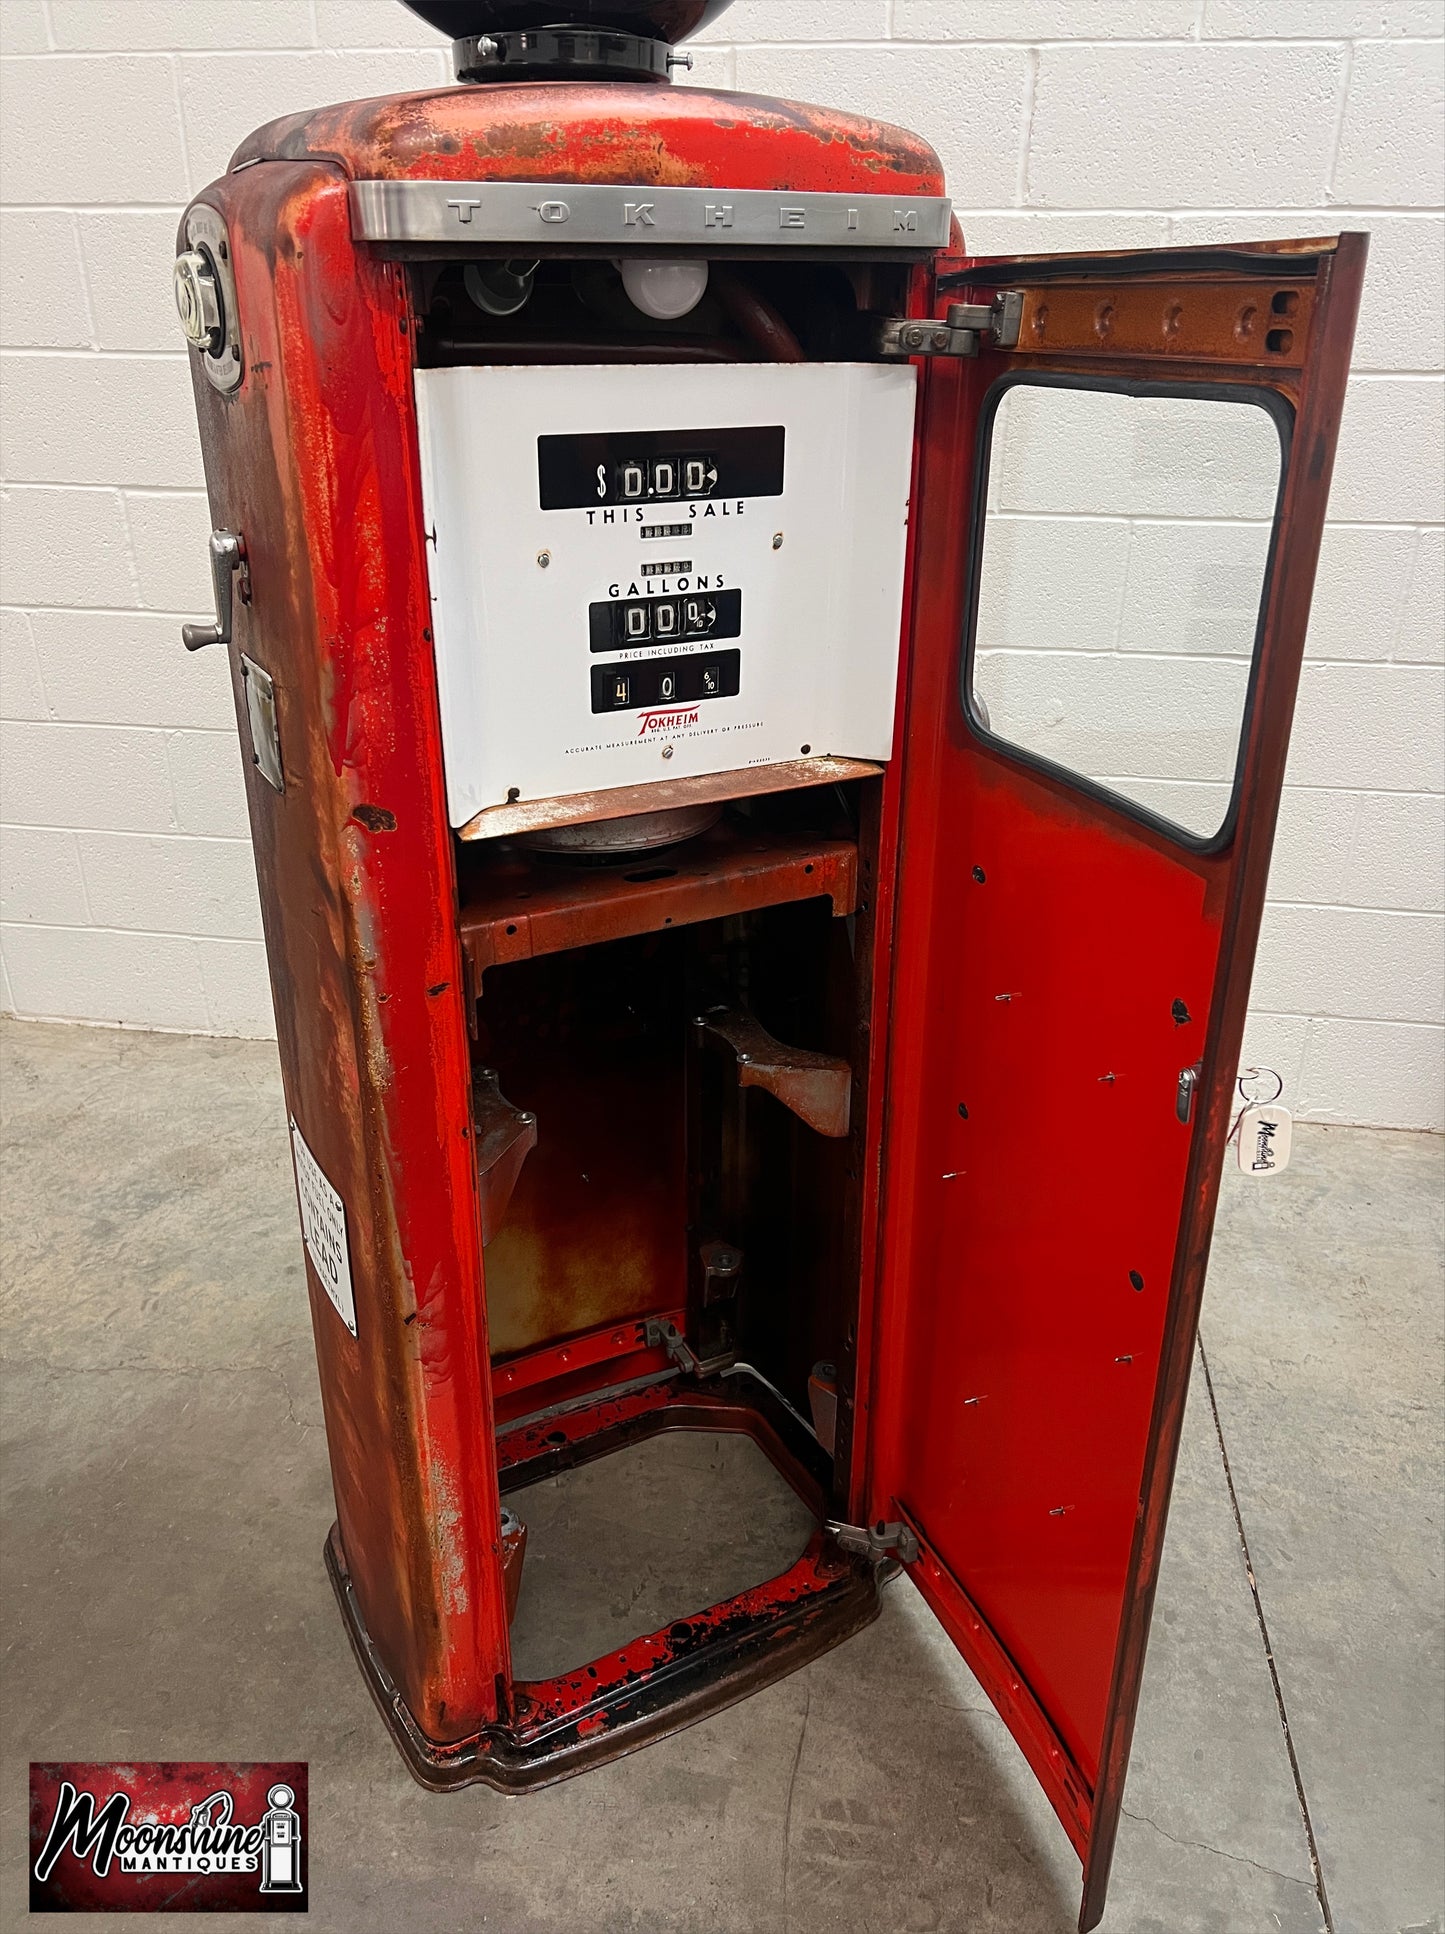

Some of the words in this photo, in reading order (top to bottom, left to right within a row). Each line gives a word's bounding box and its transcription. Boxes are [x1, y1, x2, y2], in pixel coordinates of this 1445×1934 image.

[447, 198, 917, 232] TOKHEIM
[596, 464, 607, 499] $
[586, 508, 645, 525] THIS
[688, 501, 745, 518] SALE
[608, 574, 725, 598] GALLONS
[619, 651, 643, 660] PRICE
[647, 644, 695, 657] INCLUDING
[699, 643, 715, 651] TAX
[616, 682, 627, 702] 4
[636, 704, 701, 737] TOKHEIM
[564, 744, 603, 755] ACCURATE
[606, 736, 657, 749] MEASUREMENT
[659, 734, 669, 742] AT
[672, 732, 686, 740] ANY
[688, 728, 719, 737] DELIVERY
[300, 1176, 343, 1265] CONTAINS
[308, 1214, 339, 1285] LEAD
